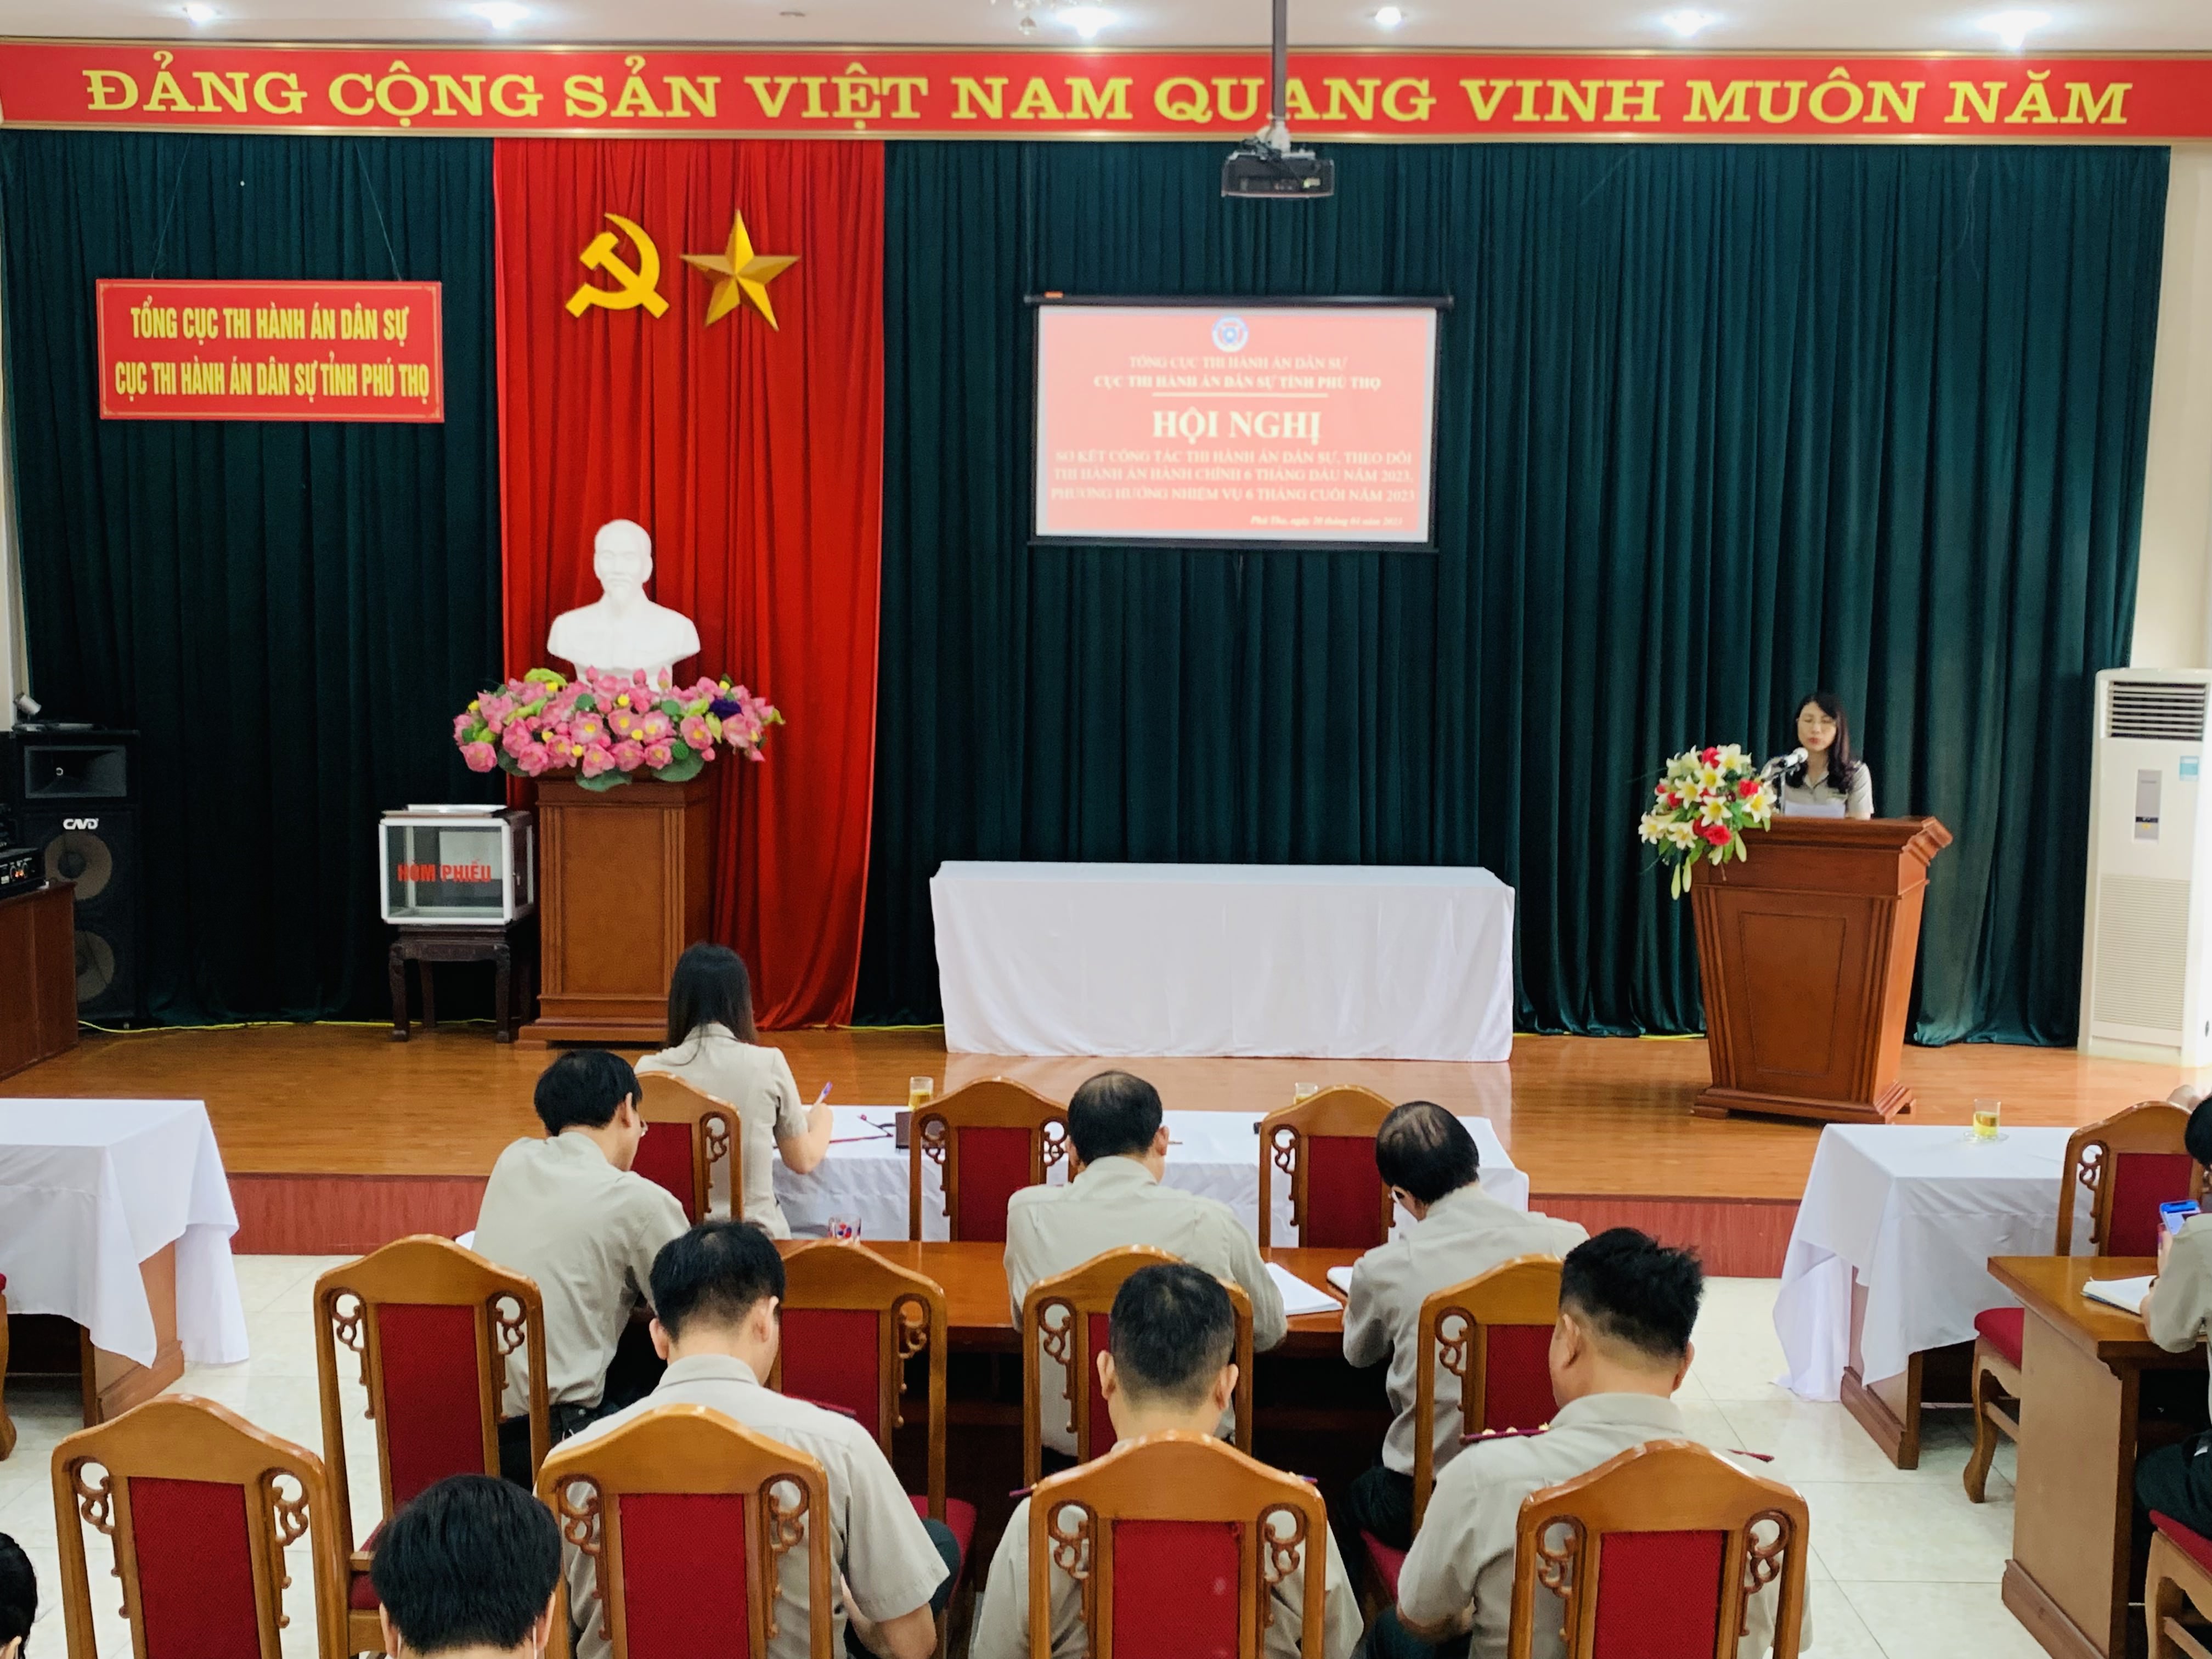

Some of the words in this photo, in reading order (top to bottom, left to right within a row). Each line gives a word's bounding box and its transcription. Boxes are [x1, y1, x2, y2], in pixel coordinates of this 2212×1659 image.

[82, 50, 308, 114] ĐẢNG
[328, 60, 544, 127] CỘNG
[563, 55, 721, 118] SẢN
[744, 63, 929, 129] VIỆT
[951, 77, 1133, 120] NAM
[1154, 77, 1437, 123] QUANG
[1459, 78, 1664, 122] VINH
[1683, 66, 1926, 124] MUÔN
[1944, 69, 2134, 125] NĂM
[130, 295, 178, 339] TỔNG
[182, 307, 219, 346] CỤC
[223, 307, 252, 339] THI
[256, 301, 306, 340] HÀNH
[310, 302, 336, 340] ÁN
[340, 303, 379, 340] DÂN
[382, 307, 410, 347] SỰ
[115, 362, 148, 402] CỤC
[151, 362, 177, 395] THI
[180, 355, 225, 395] HÀNH
[229, 356, 253, 396] ÁN
[256, 357, 291, 396] DÂN
[294, 360, 318, 403] SỰ
[320, 351, 358, 396] TỈNH
[361, 357, 396, 397] PHÚ
[398, 363, 430, 404] THỌ
[1128, 374, 1152, 387] THI
[1153, 406, 1219, 445] HỘI
[1229, 410, 1322, 445] NGHỊ
[441, 856, 491, 883] PHIẾU
